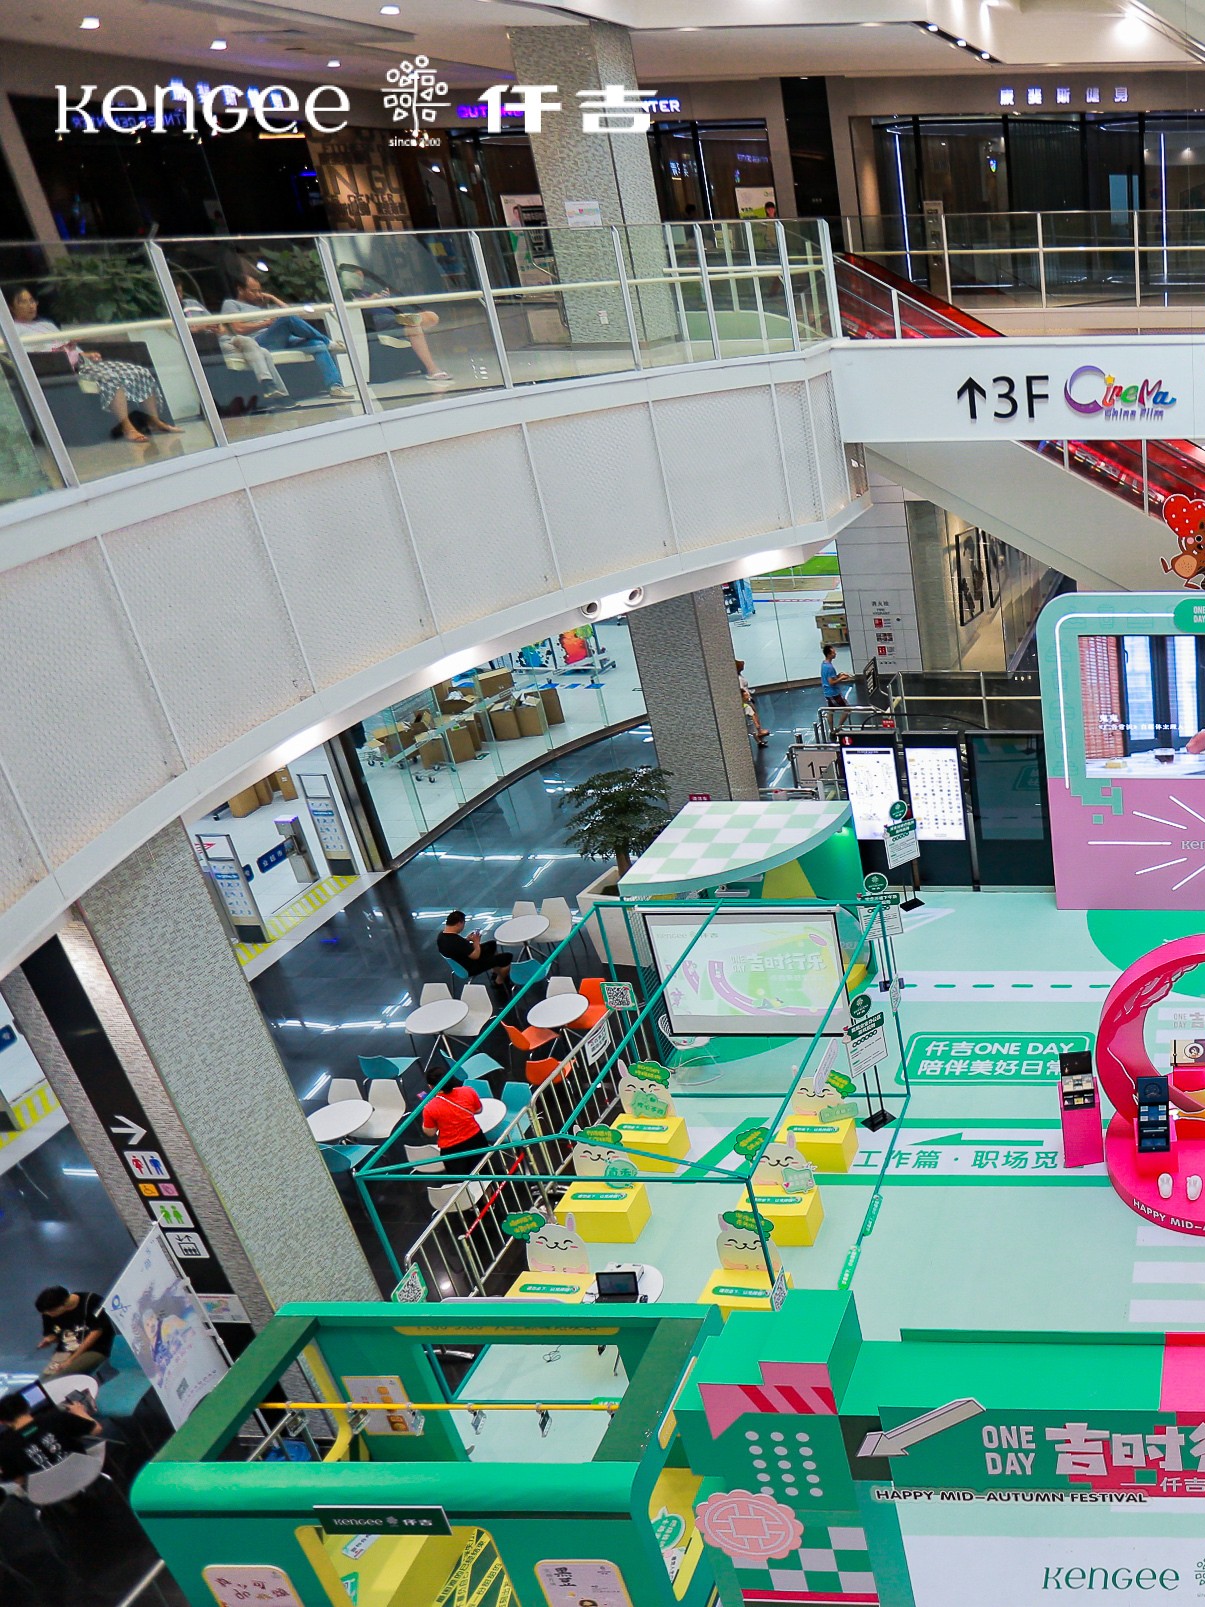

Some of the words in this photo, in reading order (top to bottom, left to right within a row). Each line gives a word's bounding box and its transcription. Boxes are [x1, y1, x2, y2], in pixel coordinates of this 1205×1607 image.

[991, 374, 1050, 420] 3F
[1193, 615, 1205, 623] DAY
[925, 1040, 1021, 1058] 仟吉ONE
[1026, 1041, 1075, 1058] DAY
[853, 1148, 1072, 1171] 工作篇·职场觅
[1131, 1197, 1167, 1223] HAPPY
[982, 1426, 1036, 1450] ONE
[986, 1452, 1036, 1476] DAY
[877, 1489, 936, 1504] HAPPY
[1070, 1489, 1148, 1504] FESTIVAL
[332, 1517, 384, 1527] Kengee
[402, 1518, 433, 1527] 仟吉
[1042, 1565, 1181, 1592] Kengee
